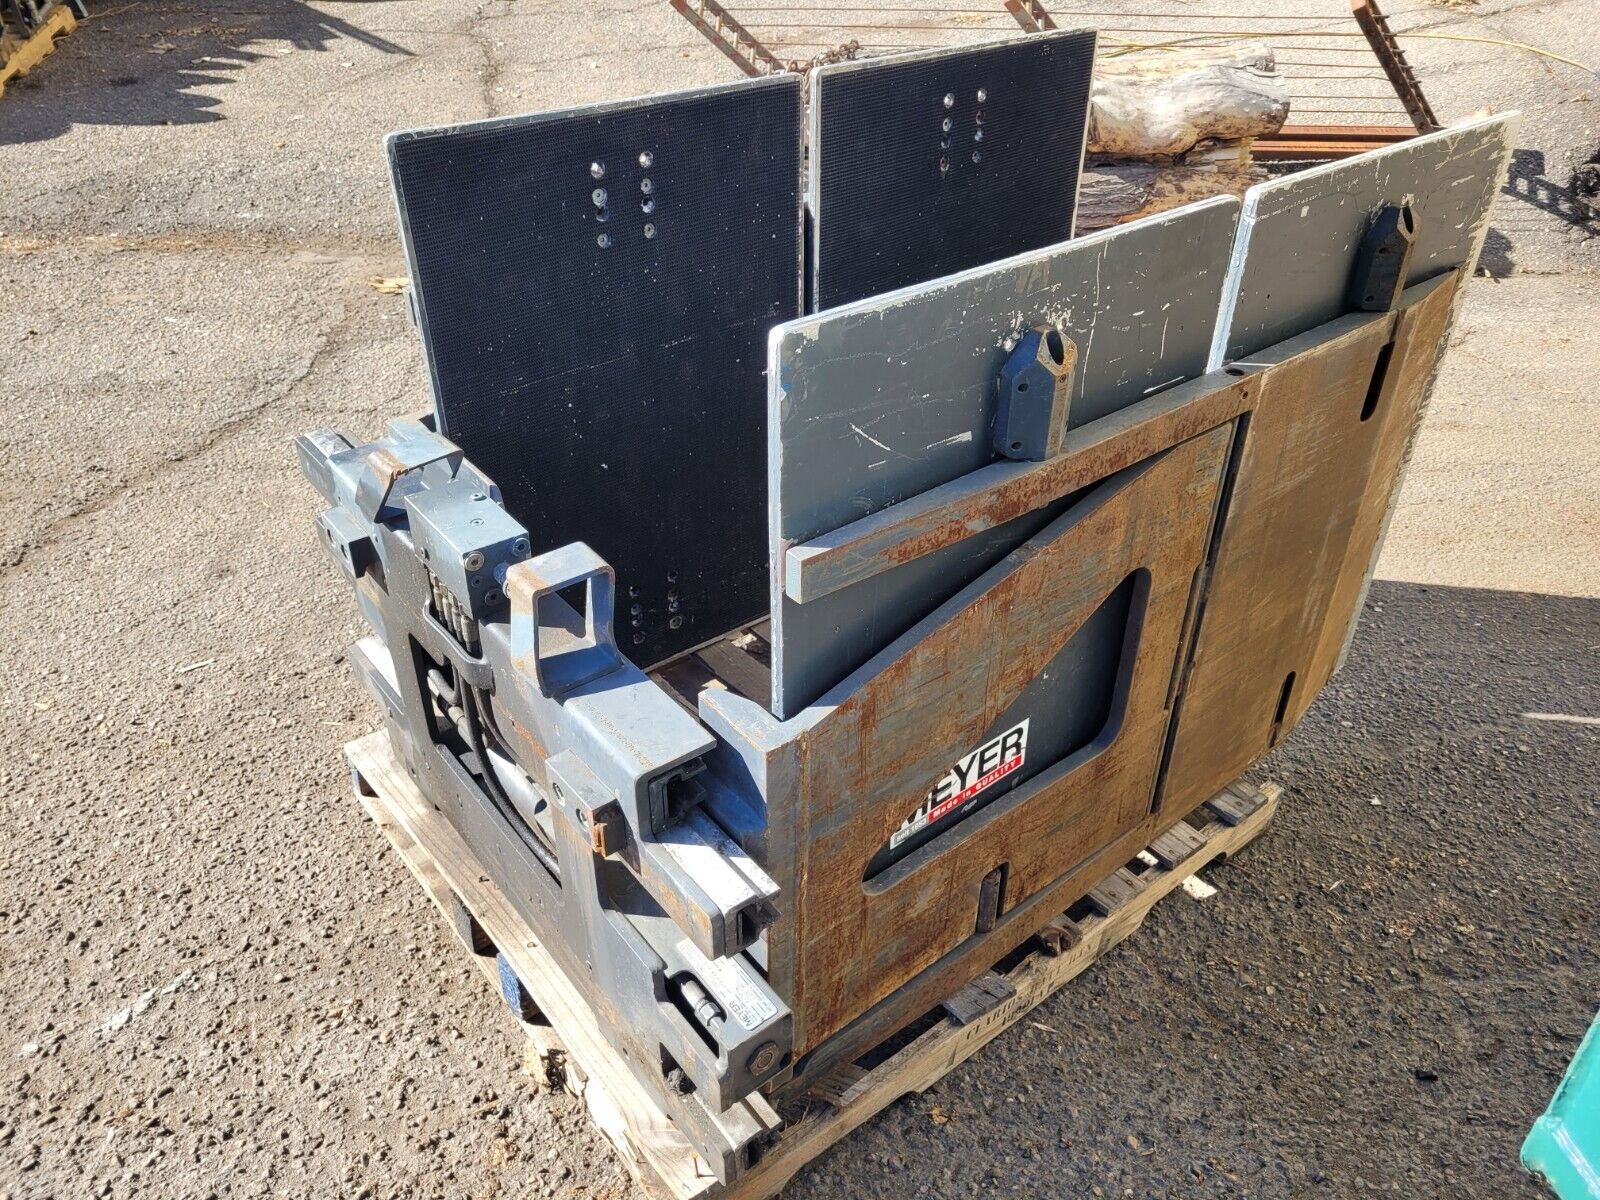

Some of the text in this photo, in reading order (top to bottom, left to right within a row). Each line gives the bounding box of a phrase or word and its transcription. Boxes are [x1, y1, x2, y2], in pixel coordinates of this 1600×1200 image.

[932, 759, 1018, 819] Made in QUALITY
[729, 1001, 753, 1027] MEYER
